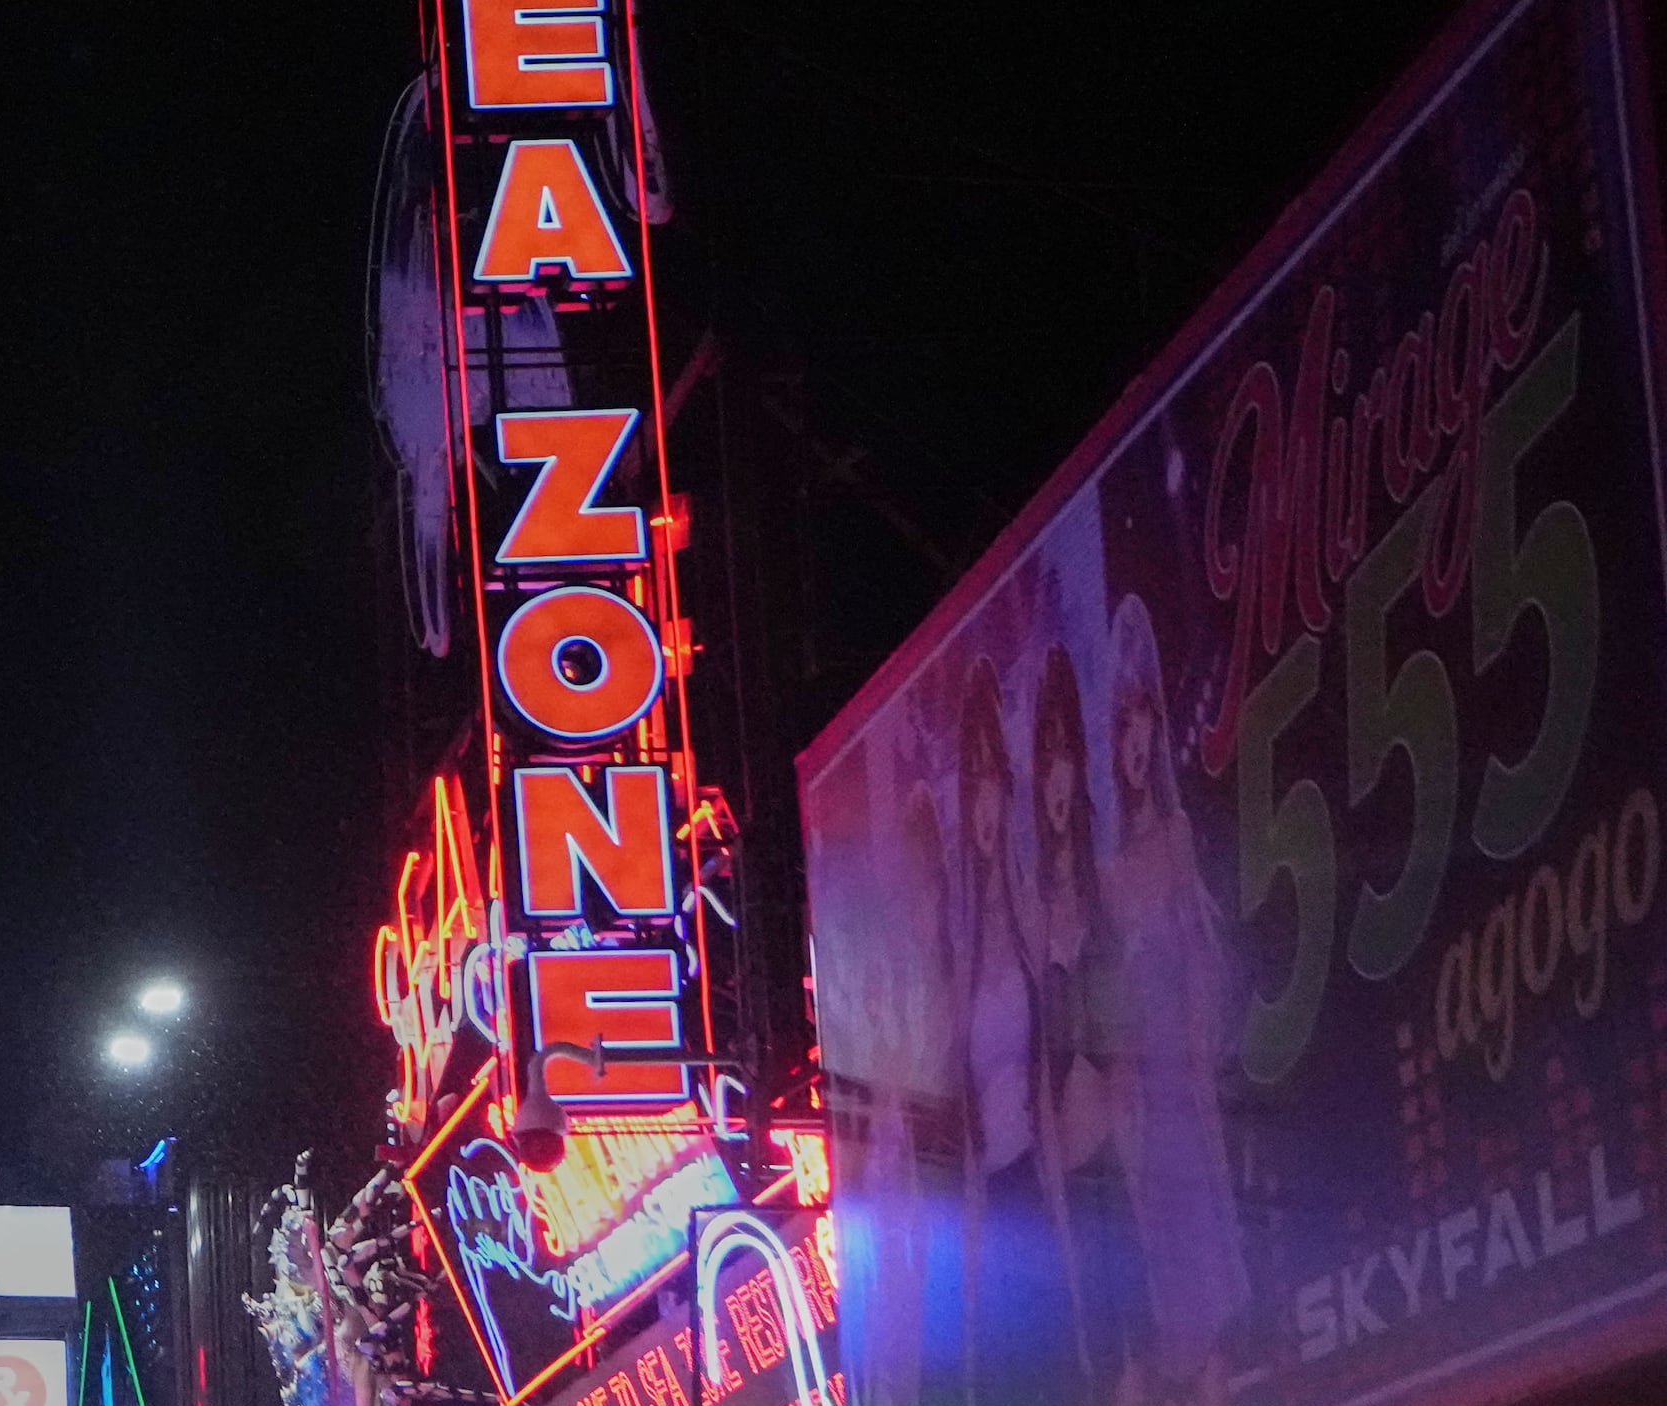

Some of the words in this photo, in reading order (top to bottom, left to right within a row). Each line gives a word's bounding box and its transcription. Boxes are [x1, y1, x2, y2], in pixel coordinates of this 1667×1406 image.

[495, 407, 691, 1103] ZONE
[1202, 188, 1549, 778] Mirage
[1237, 310, 1601, 1086] 555
[1433, 786, 1664, 1083] agogo
[1292, 1143, 1646, 1363] SKYFALL
